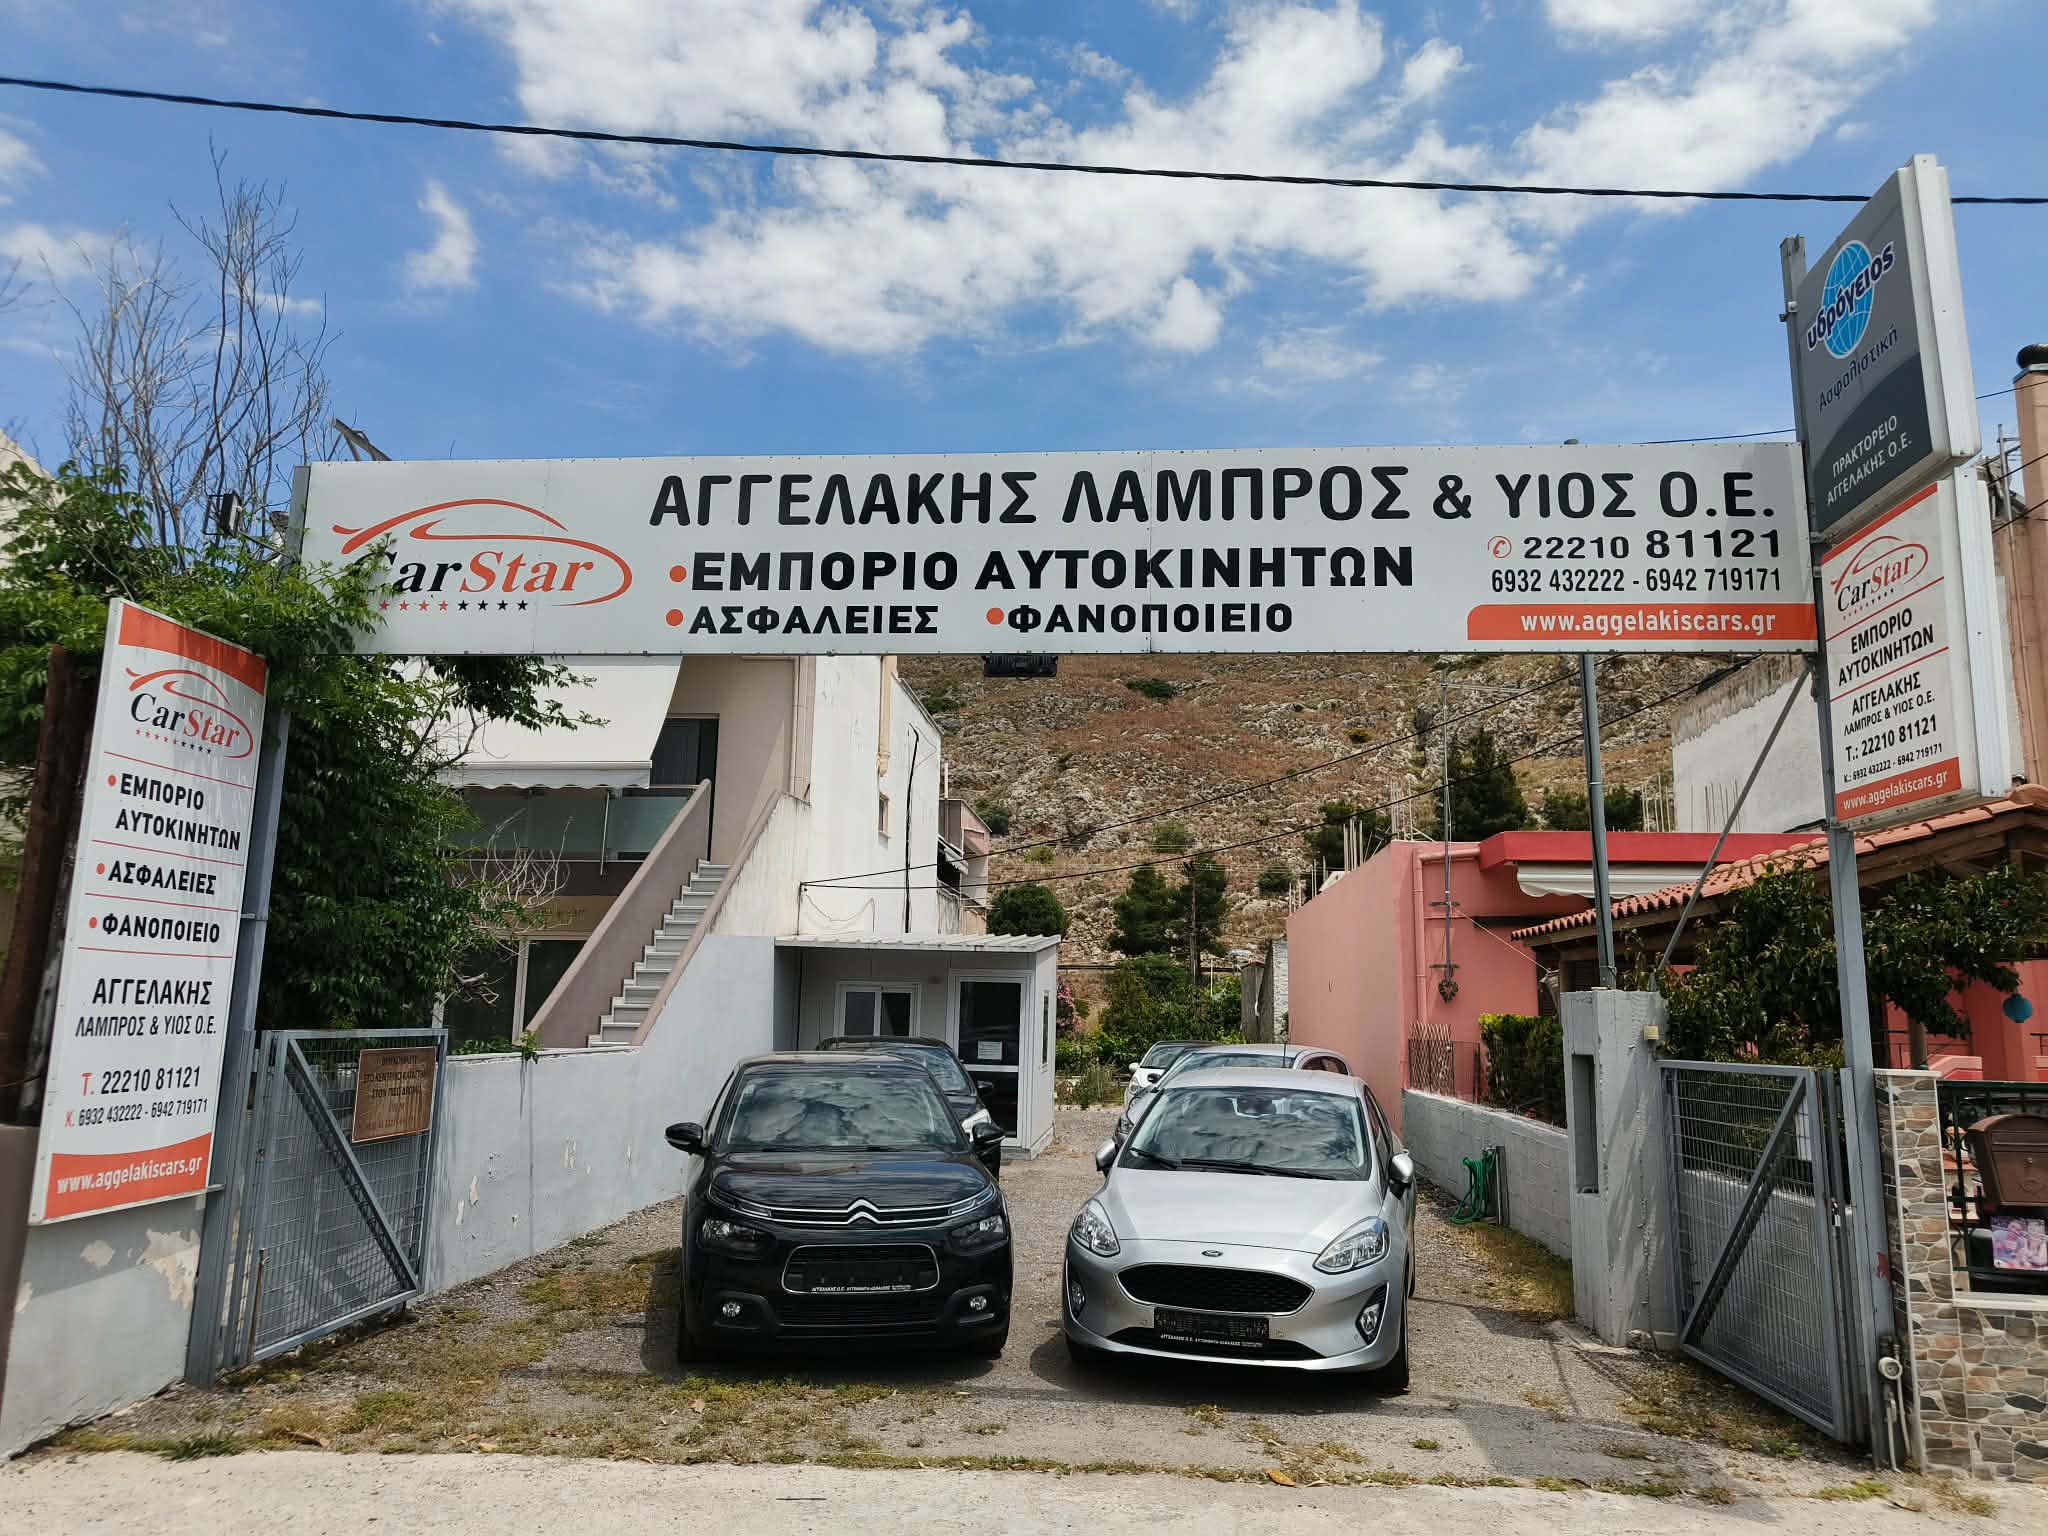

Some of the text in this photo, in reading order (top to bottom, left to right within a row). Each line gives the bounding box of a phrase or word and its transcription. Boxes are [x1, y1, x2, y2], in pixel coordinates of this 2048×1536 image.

[1832, 415, 1897, 478] ΠΡΑΚΤΟΡΕΙΟ
[649, 465, 1775, 526] ΑΓΓΕΛΑΚΗΣ ΛΑΜΠΡΟΣ & ΥΙΟΣ Ο.Ε.
[1827, 449, 1886, 505] ΑΓΓΕΛΑΚΗΣ
[1523, 529, 1780, 560] 22210 81121
[691, 546, 1414, 592] ΕΜΠΟΡΙΟ ΑΥΤΟΚΙΝΗΤΩΝ
[1491, 568, 1542, 593] 6932
[1549, 568, 1625, 592] 432222
[1646, 568, 1697, 592] 6942
[1704, 567, 1781, 592] 719171
[1837, 553, 1914, 612] CarStar
[688, 603, 1293, 635] ΑΣΦΑΛΕΙΕΣ ΦΑΝΟΠΟΙΕΙΟ
[1520, 609, 1776, 636] www.aggelakiscars.gr
[1850, 607, 1912, 655] ΕΜΠΟΡΙΟ
[1838, 623, 1935, 687] ΑΥΤΟΚΙΝΗΤΩΝ
[1851, 671, 1921, 716] ΑΓΓΕΛΑΚΗΣ
[130, 692, 241, 749] CarStar
[1844, 690, 1936, 737] ΛΑΜΠΡΟΣ & ΥΙΟΣ Ο.Ε.
[1861, 729, 1895, 757] 22210
[1898, 713, 1937, 742] 81121
[1853, 768, 1868, 781] 6932
[1868, 759, 1892, 775] 432222
[1897, 751, 1915, 767] 6942
[1916, 743, 1943, 760] 719171
[120, 773, 205, 811] ΕΜΠΟΡΙΟ
[1843, 770, 1949, 811] www.aggelakiscars.gr
[115, 808, 241, 851] ΑΥΤΟΚΙΝΗΤΩΝ
[107, 860, 217, 896] ΑΣΦΑΛΕΙΕΣ
[102, 913, 220, 943] ΦΑΝΟΠΟΙΕΙΟ
[92, 978, 212, 1005] ΑΓΓΕΛΑΚΗΣ
[75, 1015, 217, 1038] ΛΑΜΠΡΟΣ & ΥΙΟΣ Ο.Ε.
[101, 1069, 151, 1095] 22210
[155, 1066, 200, 1090] 81121
[79, 1108, 104, 1126] 6932
[106, 1103, 143, 1123] 432222
[151, 1101, 174, 1119] 6942
[176, 1097, 208, 1116] 719171
[56, 1156, 203, 1194] www.aggelakiscars.gr
